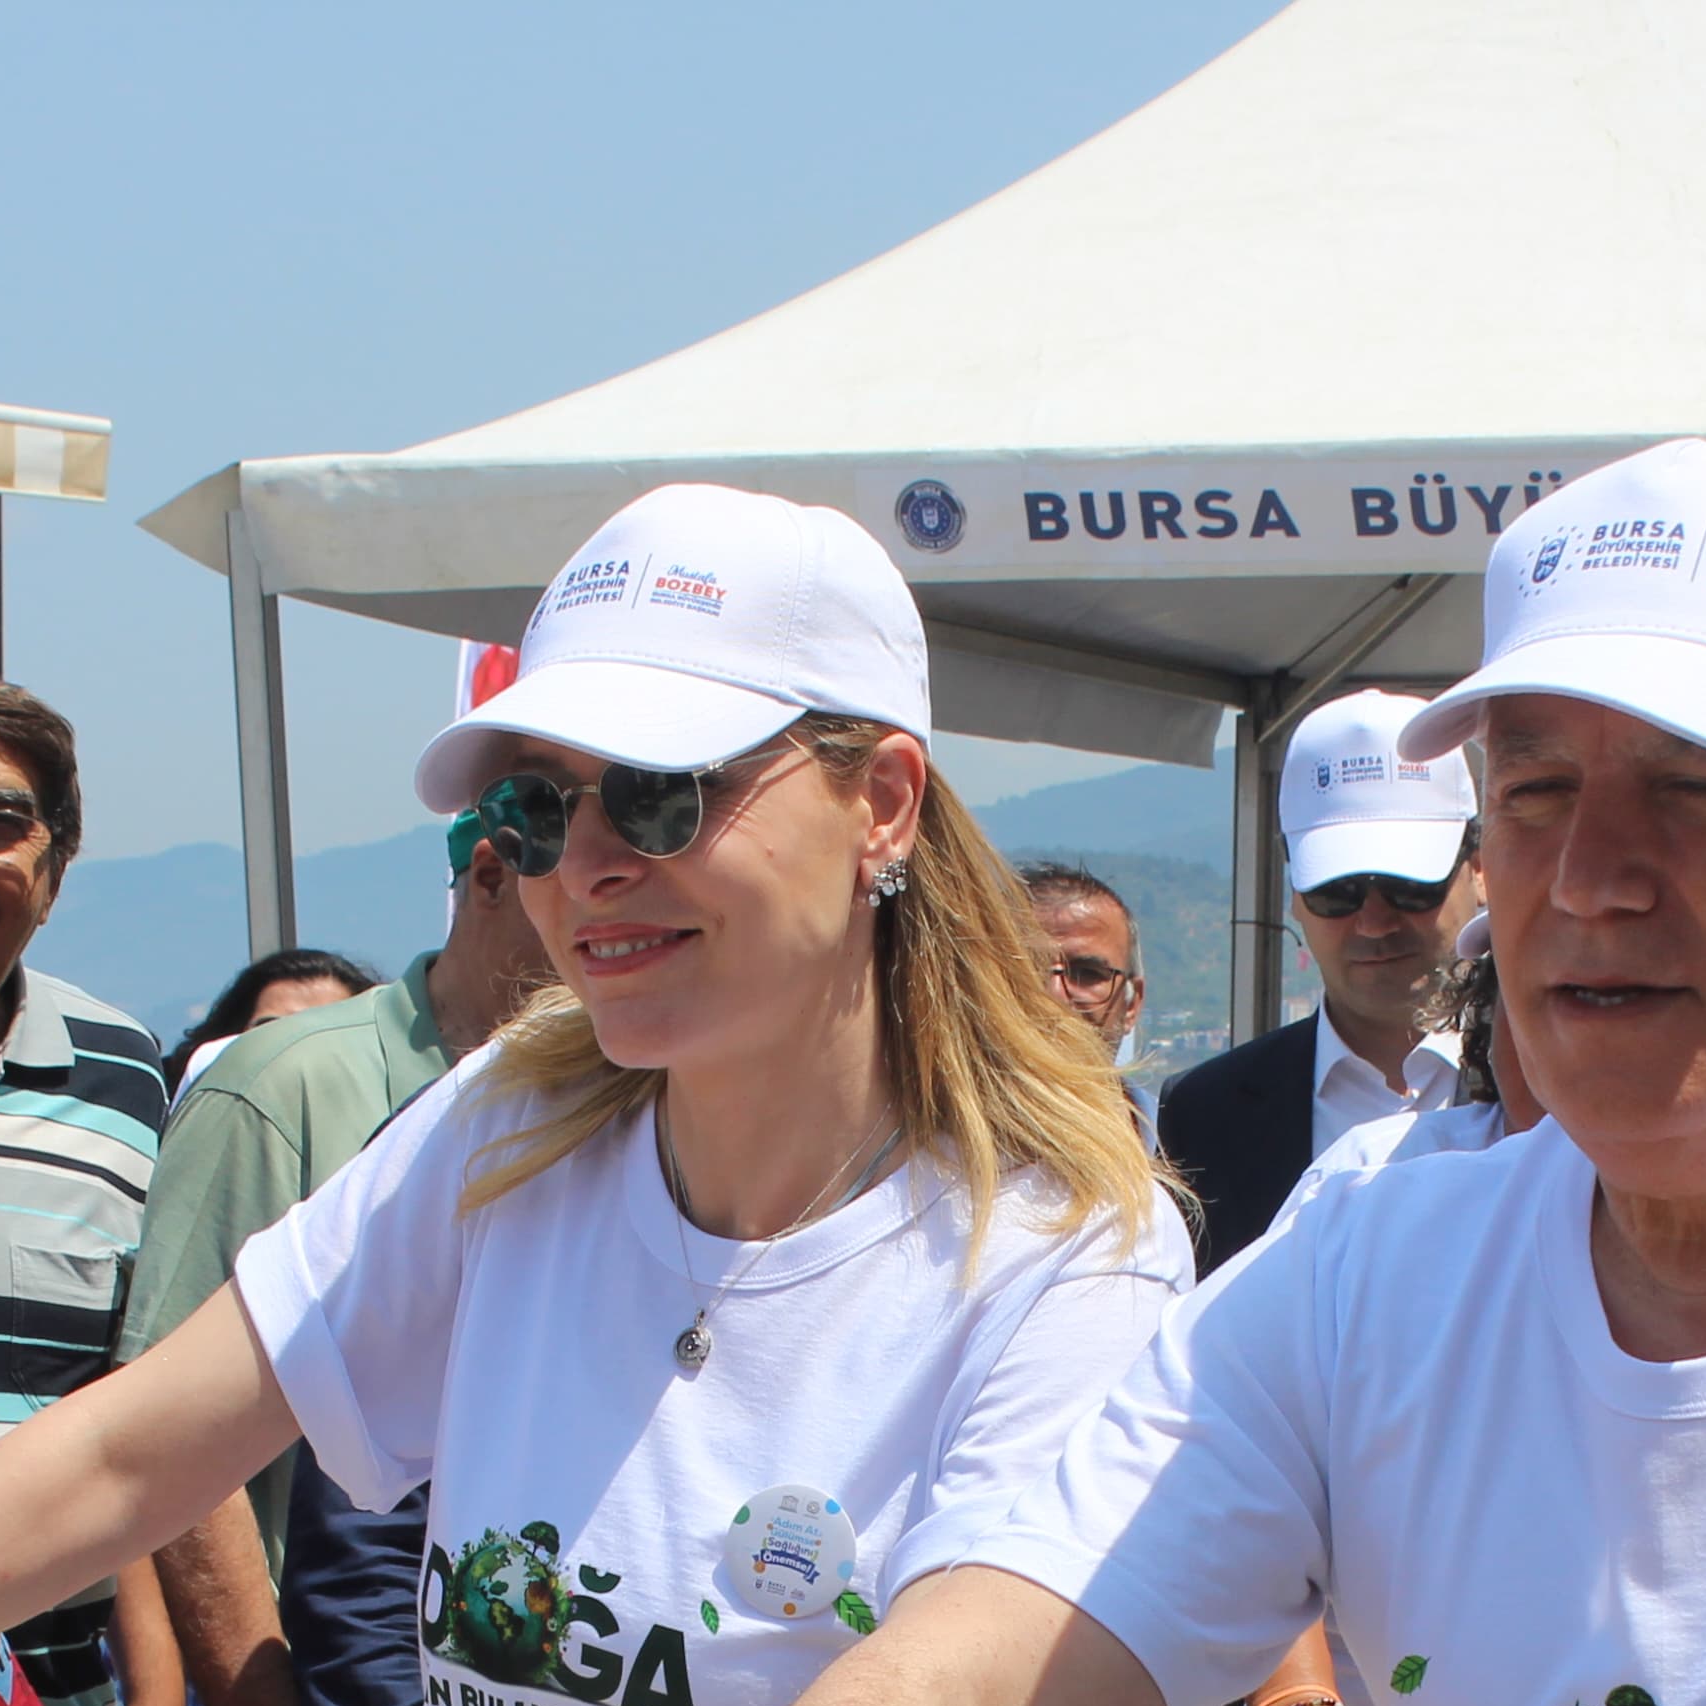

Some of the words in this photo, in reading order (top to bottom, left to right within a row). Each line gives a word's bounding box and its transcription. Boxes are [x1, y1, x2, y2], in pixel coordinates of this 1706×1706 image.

[1023, 488, 1301, 541] BURSA
[1591, 519, 1685, 542] BURSA
[1586, 538, 1683, 556] BÜYÜKŞEHİR
[1581, 551, 1681, 571] BELEDİYESİ
[565, 559, 630, 587] BURSA
[655, 576, 727, 600] BOZBEY
[1341, 755, 1384, 769] BURSA
[766, 1536, 814, 1558] Sağlığını
